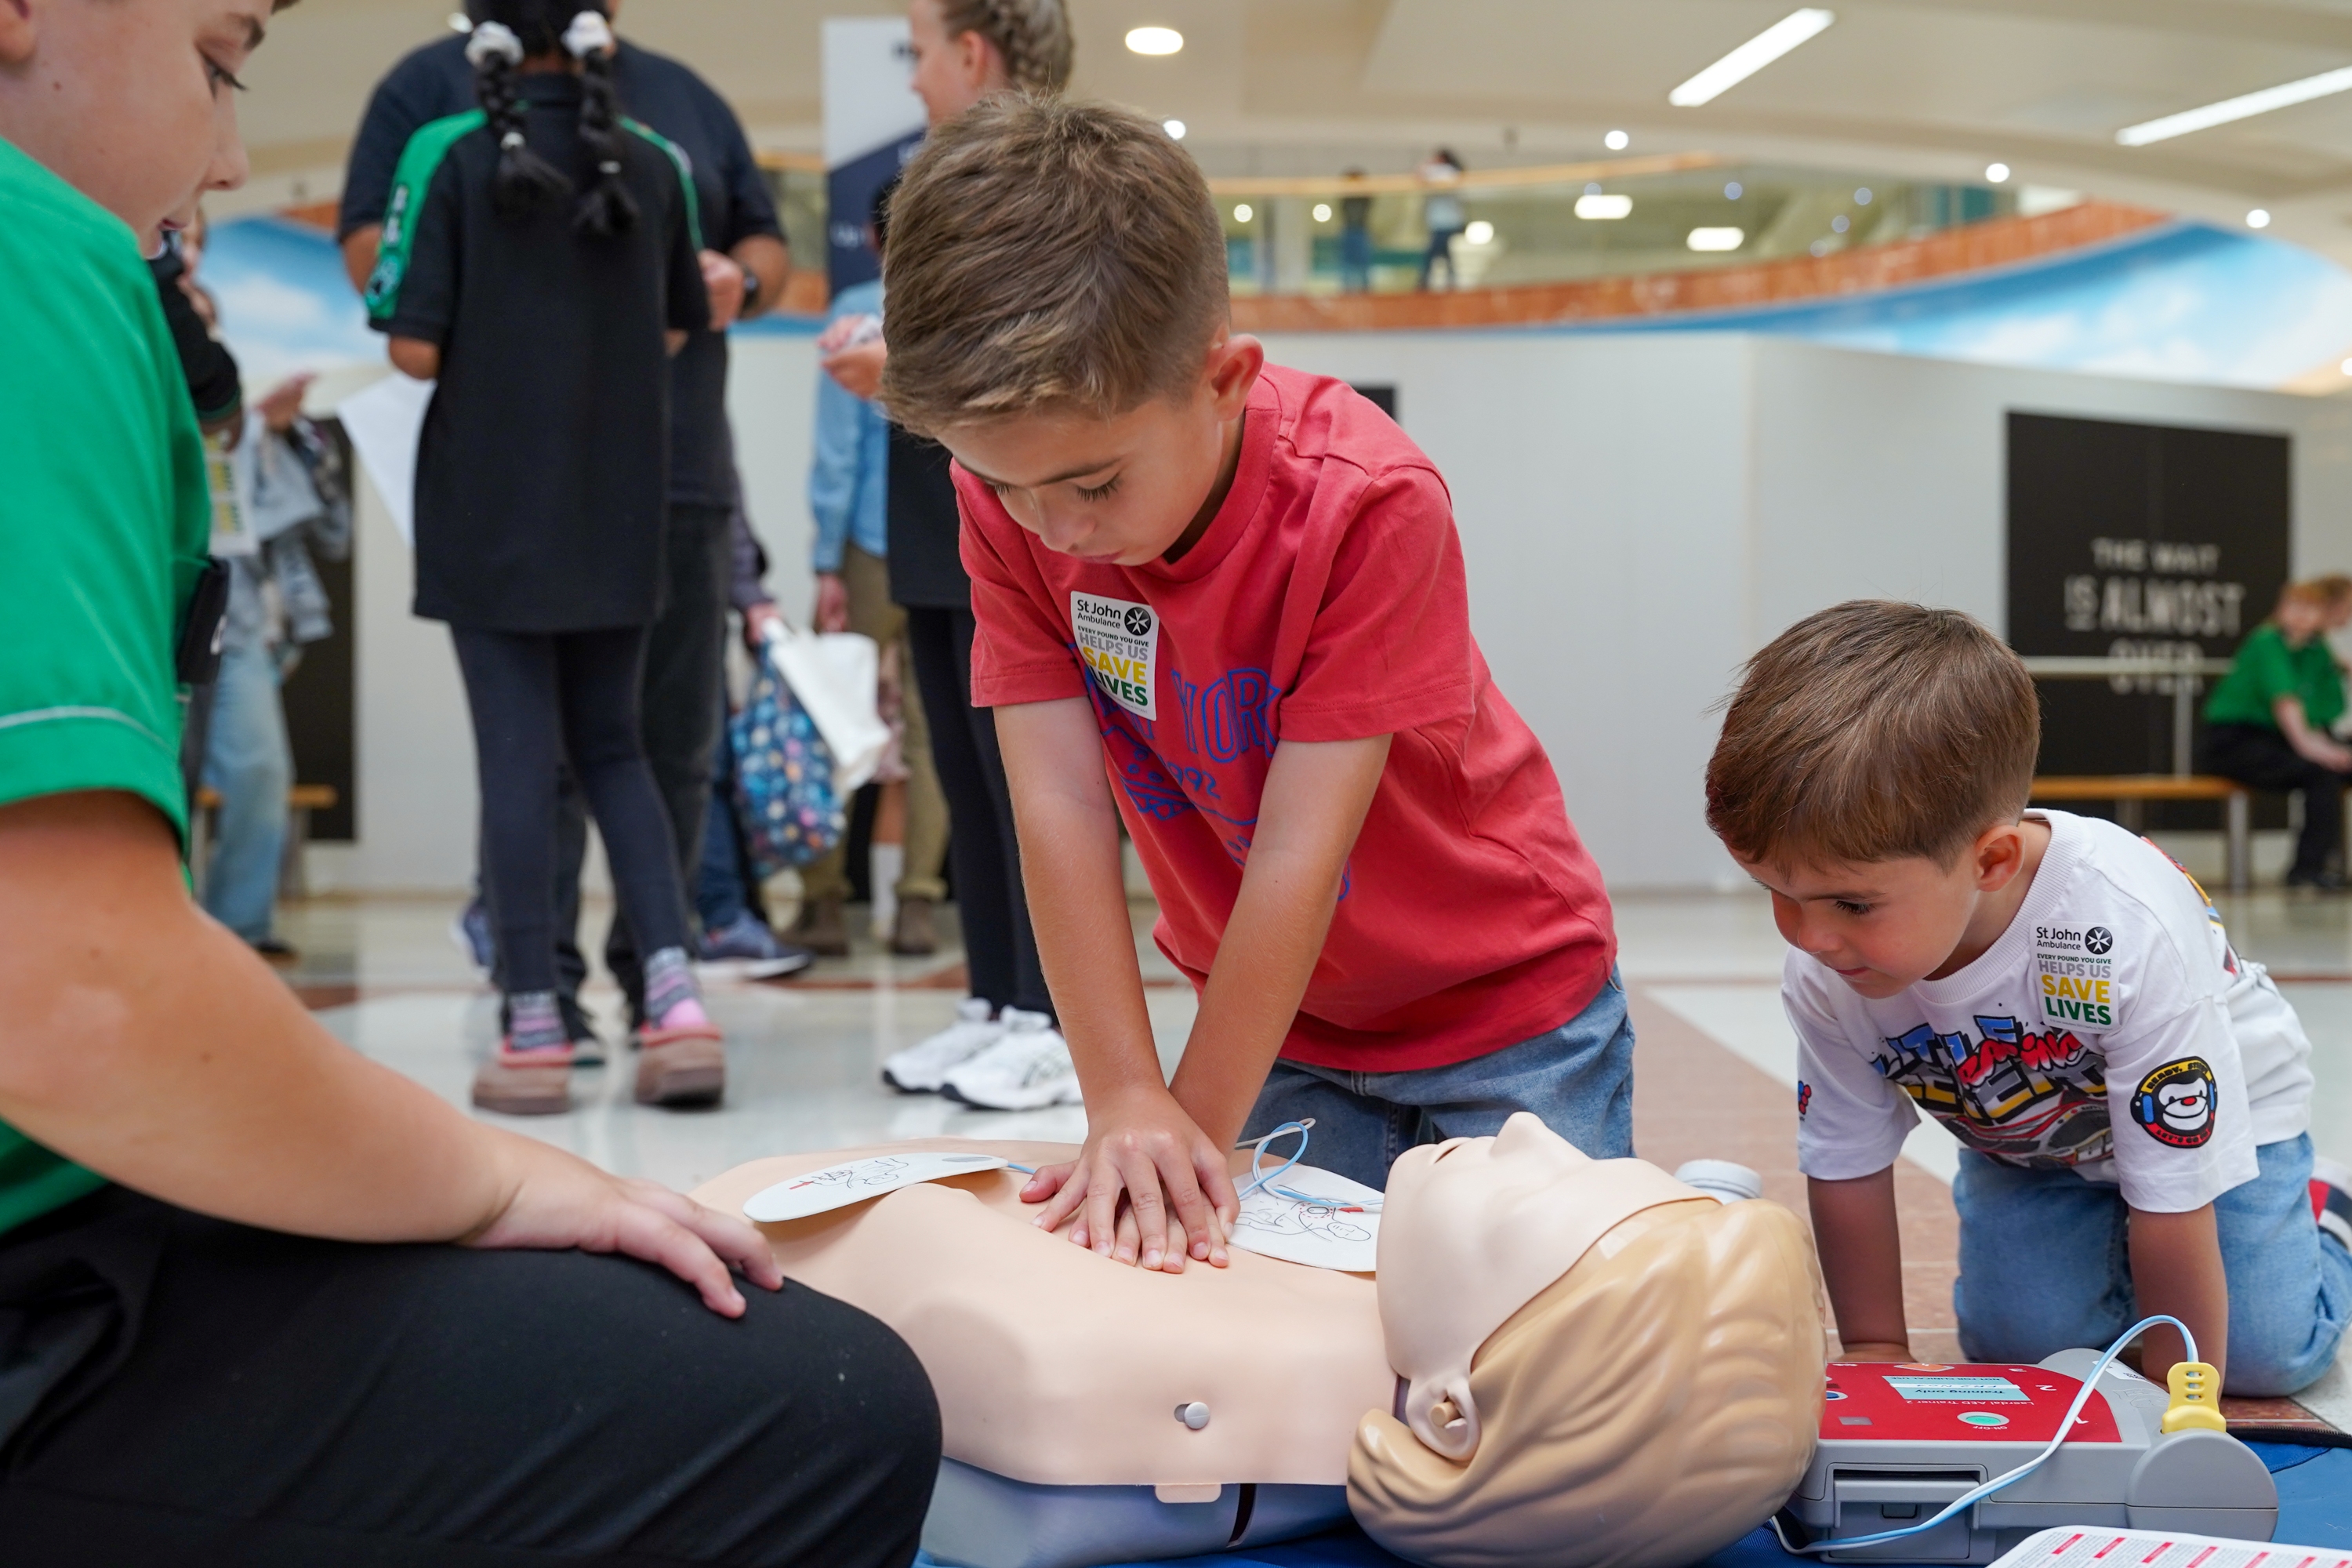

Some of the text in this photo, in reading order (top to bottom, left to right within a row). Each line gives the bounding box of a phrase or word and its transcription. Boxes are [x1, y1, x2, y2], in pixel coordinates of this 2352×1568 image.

[1077, 599, 1121, 620] St John
[2100, 575, 2245, 637] ALMOST
[1077, 612, 1121, 630] Ambulance
[1078, 625, 1149, 648] EVERY POUND YOU GIVE
[1079, 632, 1149, 662] HELPS US
[1083, 647, 1147, 686] SAVE
[1089, 665, 1149, 706] LIVES
[2036, 926, 2082, 942] St John
[2036, 940, 2082, 950] Ambulance
[2038, 960, 2111, 979] HELPS US
[2041, 974, 2111, 1004] SAVE
[2045, 996, 2112, 1025] LIVES
